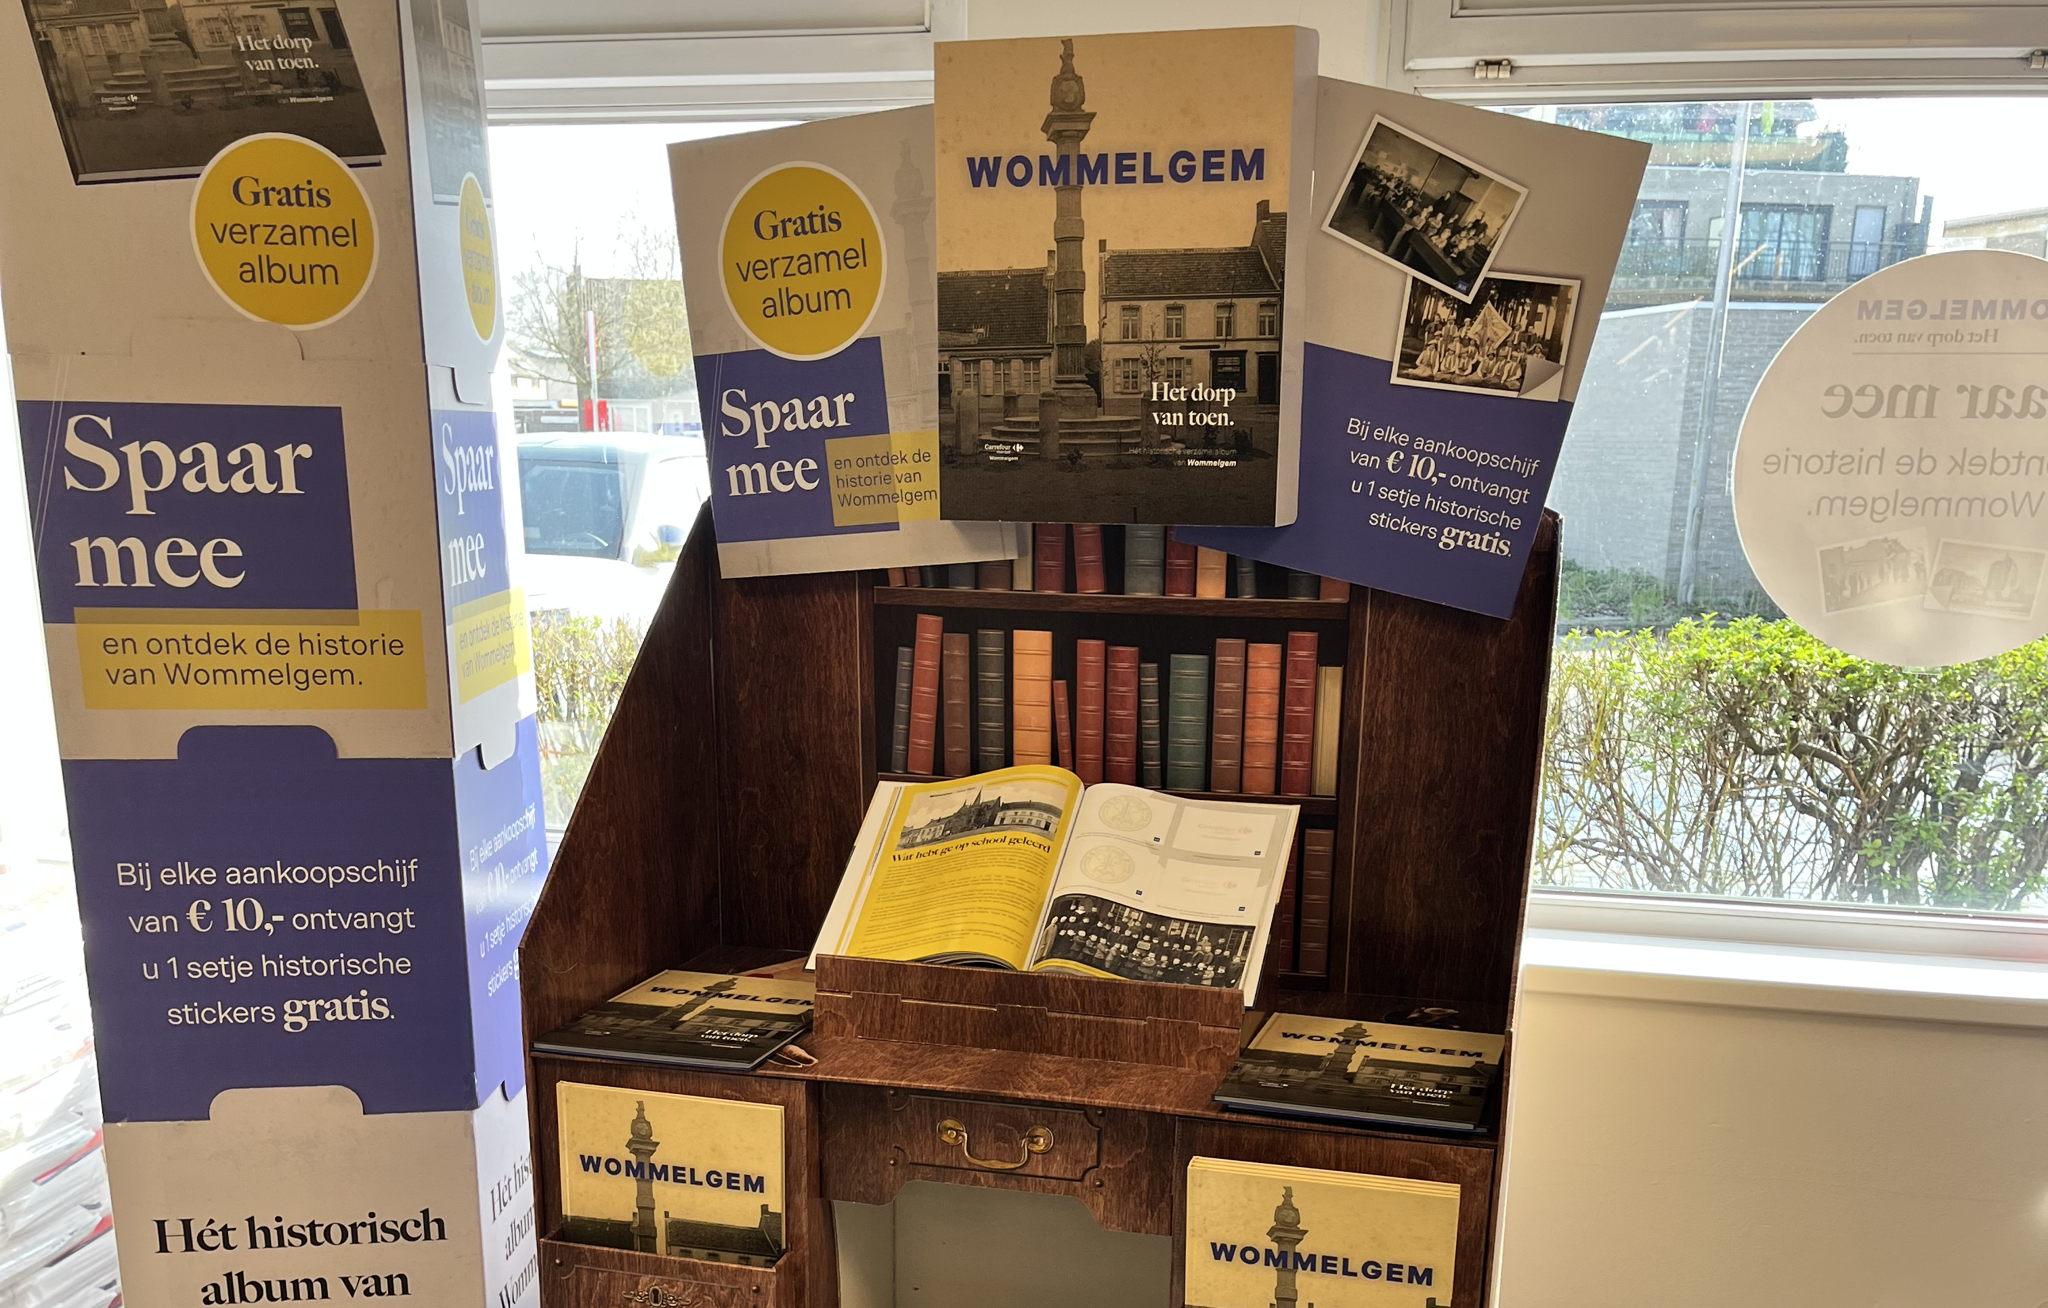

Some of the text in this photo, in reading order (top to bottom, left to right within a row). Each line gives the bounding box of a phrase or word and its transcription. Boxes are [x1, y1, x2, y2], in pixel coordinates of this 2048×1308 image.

[236, 34, 312, 53] Het dorp
[245, 56, 319, 71] van toen.
[966, 148, 1265, 189] WOMMELGEM
[232, 176, 332, 209] Gratis
[211, 218, 358, 249] verzamel
[753, 204, 842, 241] Gratis
[239, 255, 339, 286] album
[736, 238, 867, 284] verzamel
[761, 284, 851, 319] album
[1151, 381, 1236, 407] Het dorp
[720, 387, 855, 450] Spaar
[1152, 410, 1235, 426] van toen.
[64, 413, 312, 515] Spaar
[834, 448, 931, 470] en ontdek de
[1187, 459, 1237, 468] Wommelgem
[1347, 417, 1541, 478] Bij elke aankoopschijf
[442, 422, 494, 515] Spaar
[726, 454, 820, 498] mee
[836, 471, 922, 488] historie van
[1349, 450, 1531, 505] van € 10,- ontvangt
[837, 488, 938, 508] Wommelgem
[1351, 480, 1522, 531] u 1 setje historische
[1368, 511, 1513, 558] stickers gratis.
[70, 535, 246, 588] mee
[448, 532, 486, 587] mee
[102, 632, 404, 657] en ontdek de historie
[106, 662, 364, 691] van Wommelgem.
[971, 835, 1007, 847] school
[116, 858, 418, 892] Bij elke aankoopschijf
[128, 897, 416, 937] van € 10,- ontvangt
[142, 951, 412, 983] u 1 setje historische
[487, 958, 514, 997] stickers
[167, 989, 395, 1033] stickers gratis.
[1280, 1031, 1484, 1058] WOMMELGEM
[579, 1154, 766, 1194] WOMMELGEM
[490, 1174, 512, 1224] Hét
[153, 1207, 448, 1255] Hét historisch
[1210, 1242, 1434, 1286] WOMMELGEM
[200, 1267, 412, 1307] album van
